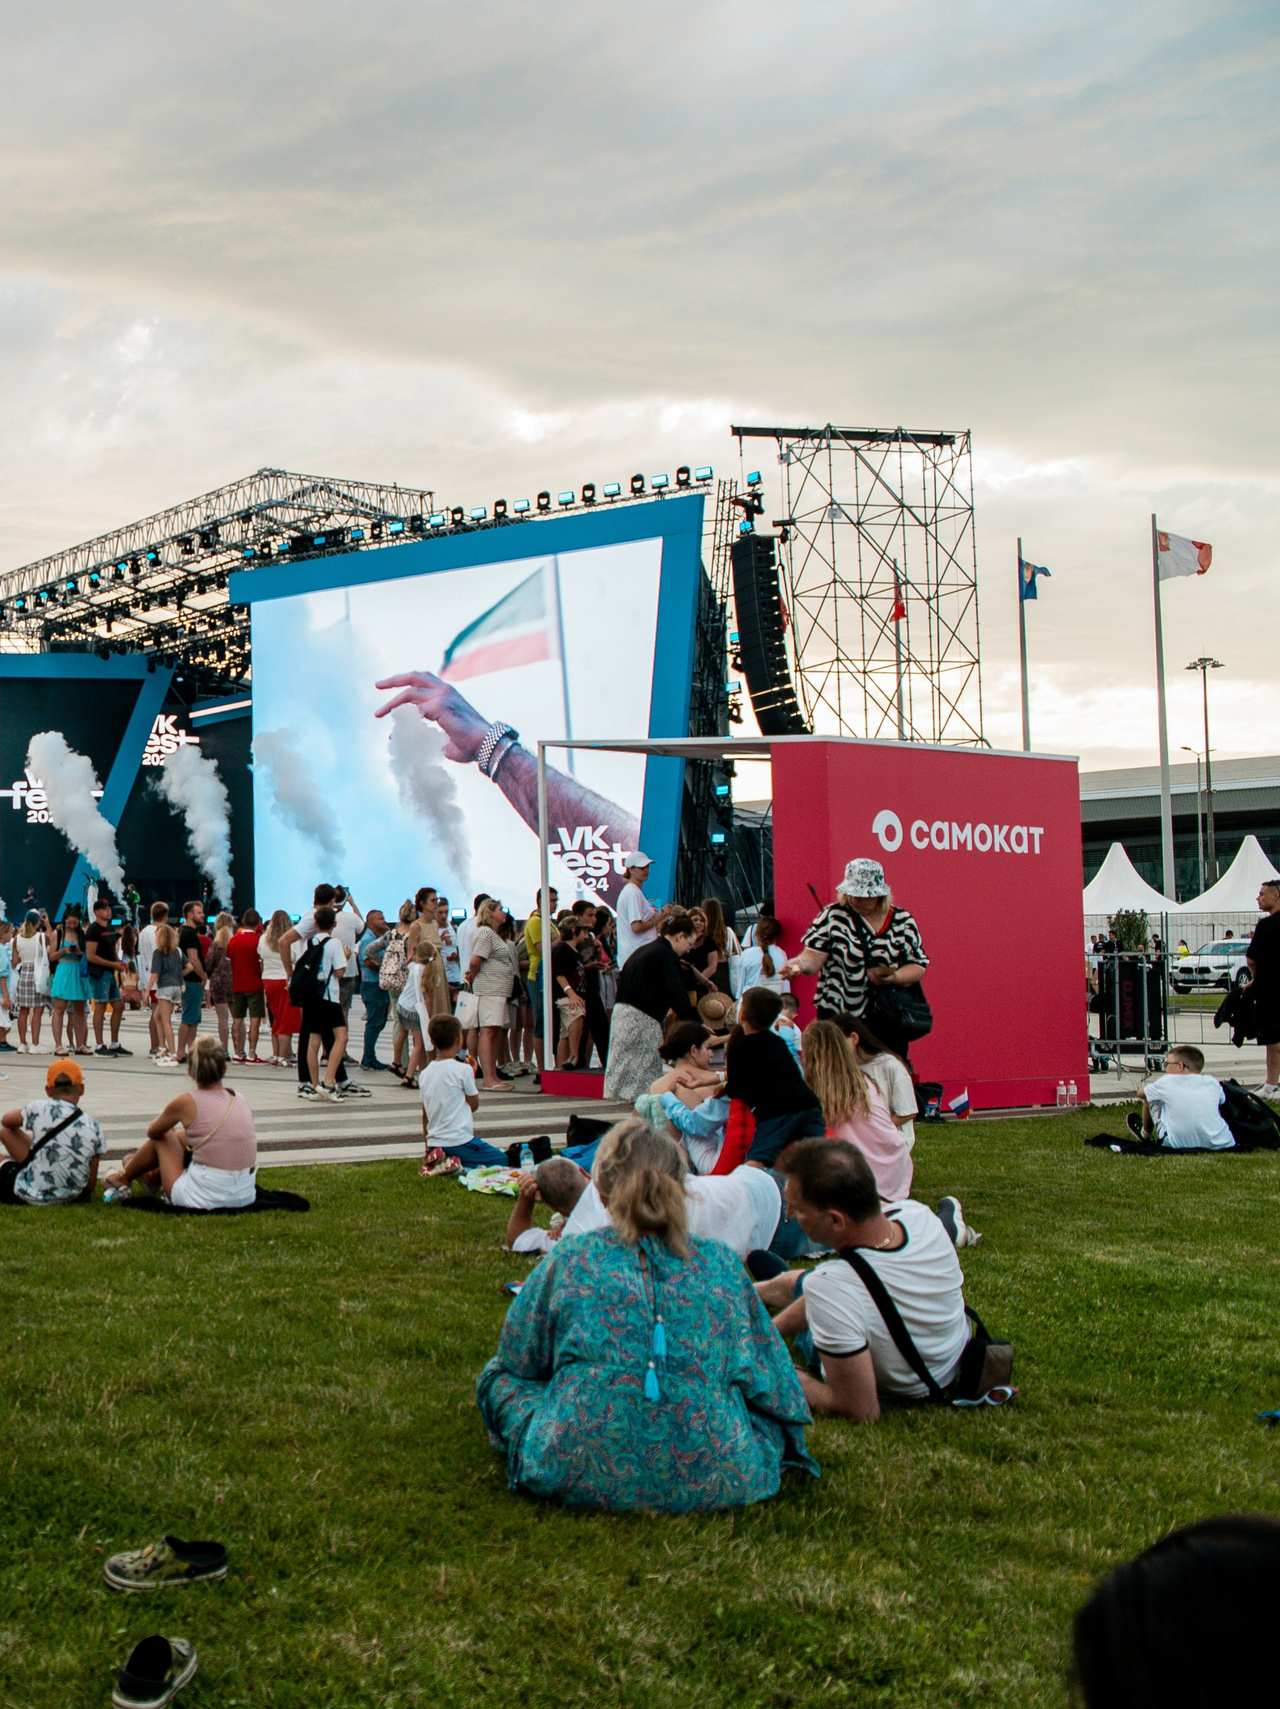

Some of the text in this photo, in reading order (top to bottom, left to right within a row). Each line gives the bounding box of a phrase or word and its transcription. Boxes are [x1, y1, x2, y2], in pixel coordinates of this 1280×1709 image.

[145, 729, 198, 755] est
[142, 753, 167, 766] 202
[6, 780, 49, 810] fe
[558, 825, 610, 851] VK
[547, 842, 632, 877] fest
